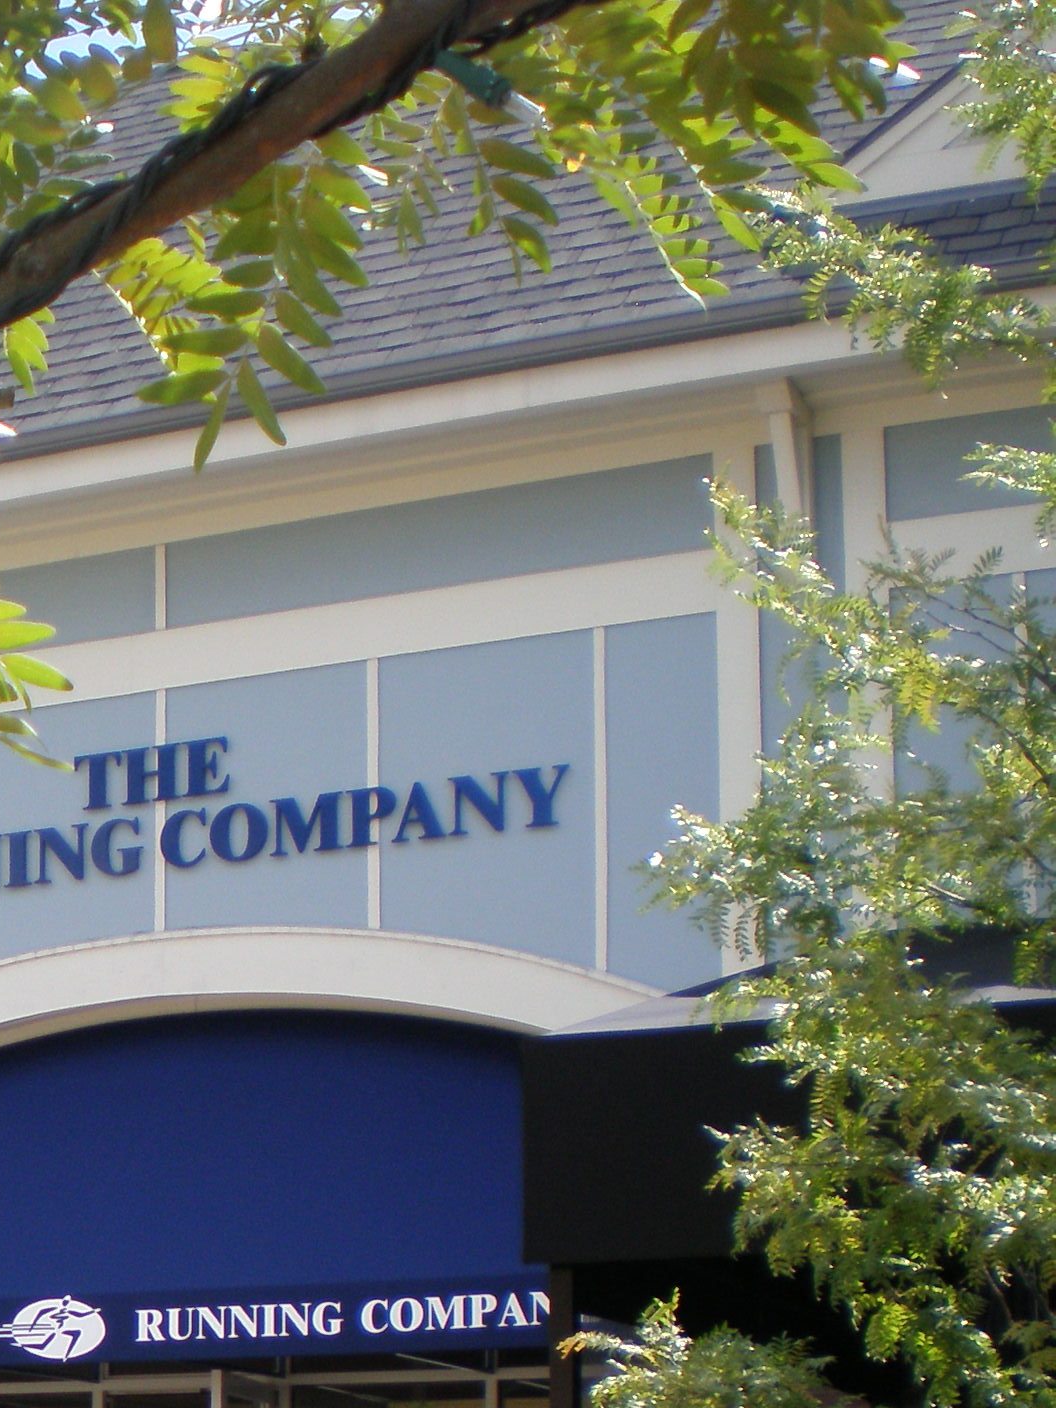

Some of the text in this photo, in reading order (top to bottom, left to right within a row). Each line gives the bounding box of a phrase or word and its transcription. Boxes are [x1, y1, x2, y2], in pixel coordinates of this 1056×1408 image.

[73, 736, 231, 811] THE
[159, 763, 571, 869] COMPANY
[135, 1301, 344, 1343] RUNNING
[360, 1291, 551, 1334] COMPAN
